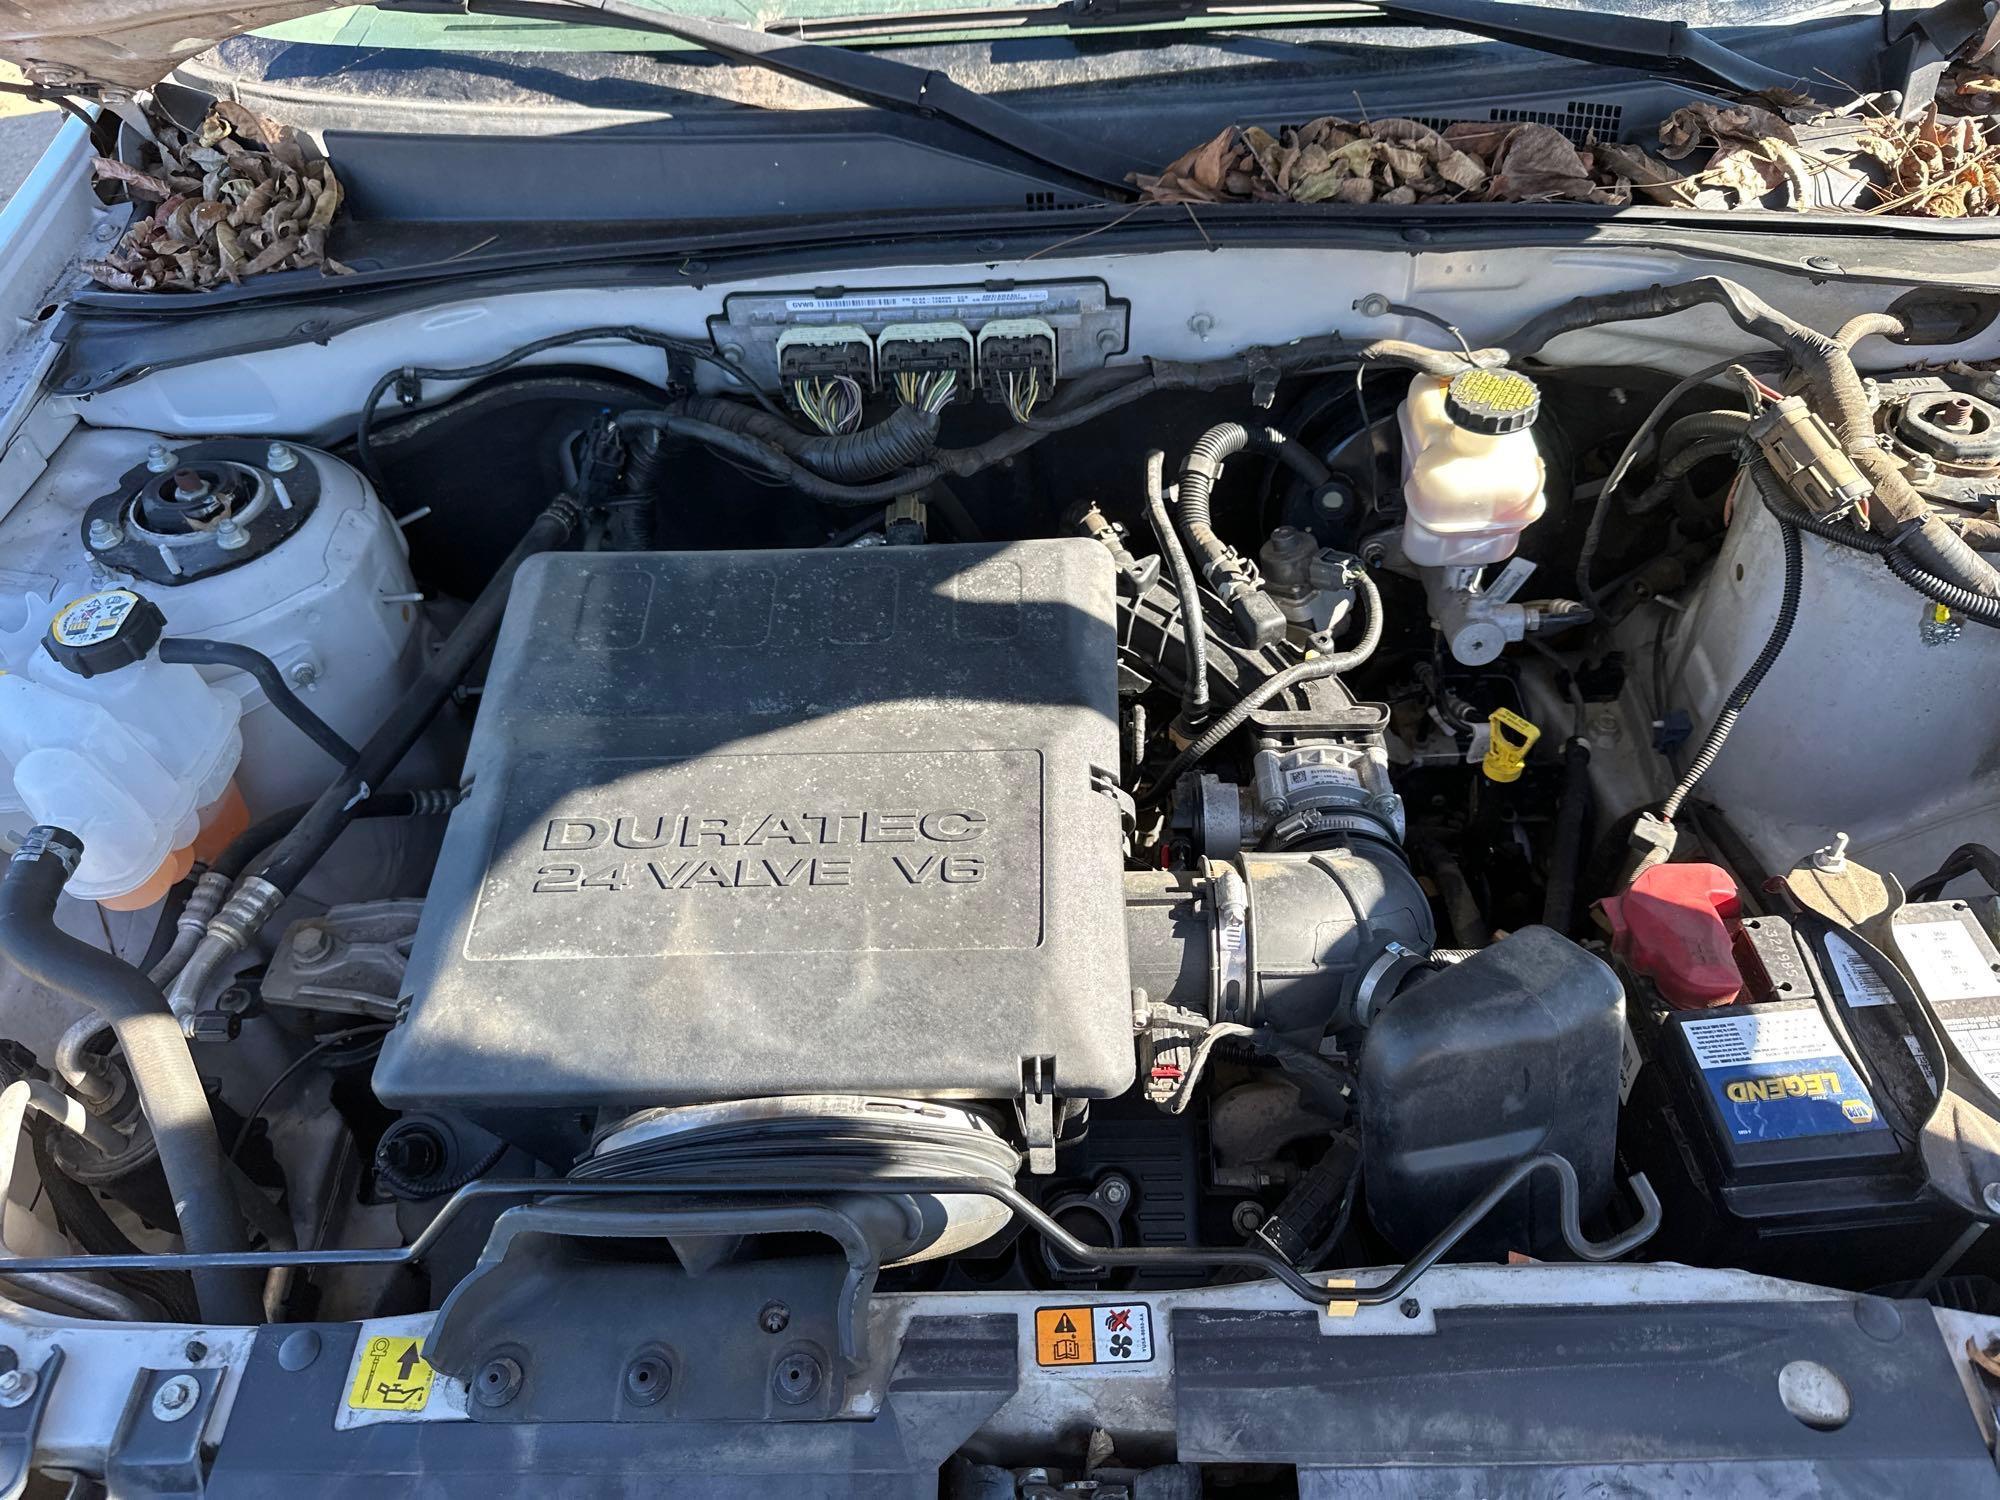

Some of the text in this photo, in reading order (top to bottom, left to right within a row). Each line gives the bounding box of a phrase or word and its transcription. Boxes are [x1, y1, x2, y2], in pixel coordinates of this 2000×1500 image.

[542, 808, 987, 851] DURATEC
[532, 853, 985, 893] 24 VALVE V6
[1726, 1072, 1844, 1104] LEGEND
[1845, 1105, 1869, 1118] NAPA
